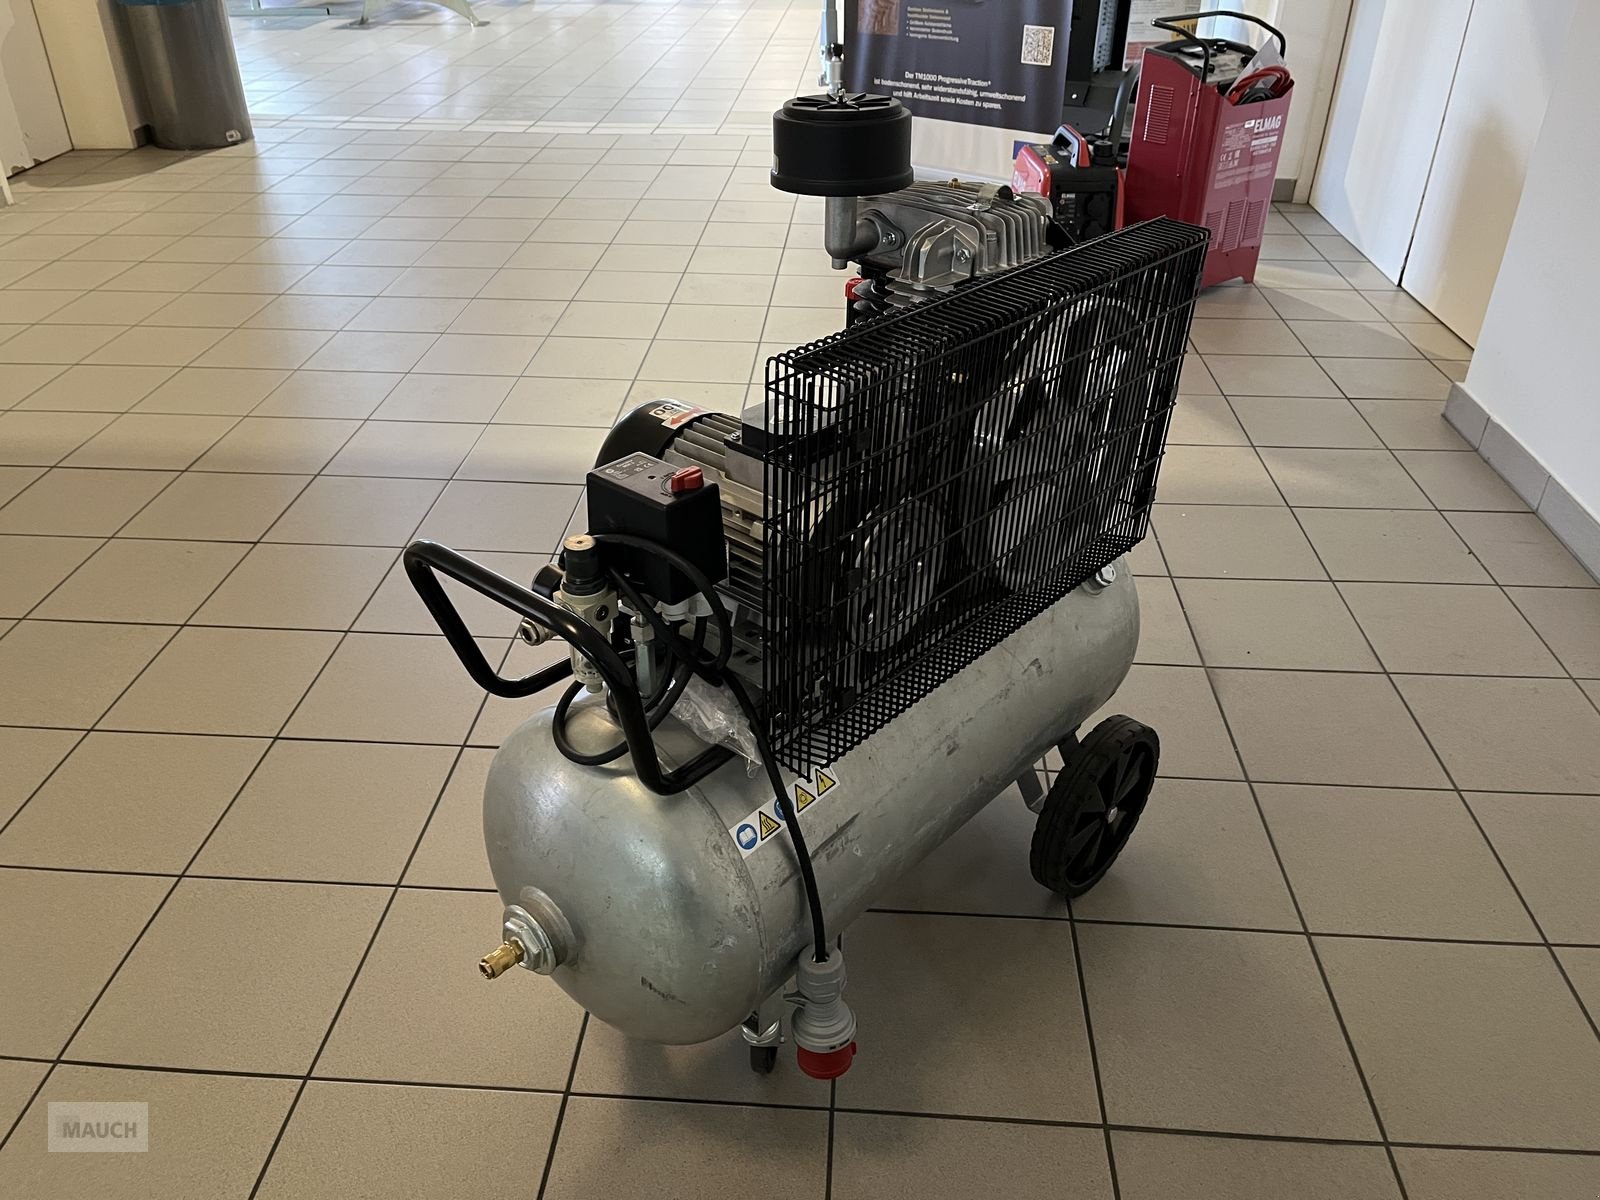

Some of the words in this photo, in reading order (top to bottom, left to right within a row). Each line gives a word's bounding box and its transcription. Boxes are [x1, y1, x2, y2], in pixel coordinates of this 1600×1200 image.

[905, 71, 915, 79] Der
[915, 72, 937, 82] TM1000
[940, 96, 956, 104] sowie
[956, 97, 975, 106] Kosten
[980, 91, 1026, 103] umweltschonend
[1253, 114, 1282, 134] ELMAG
